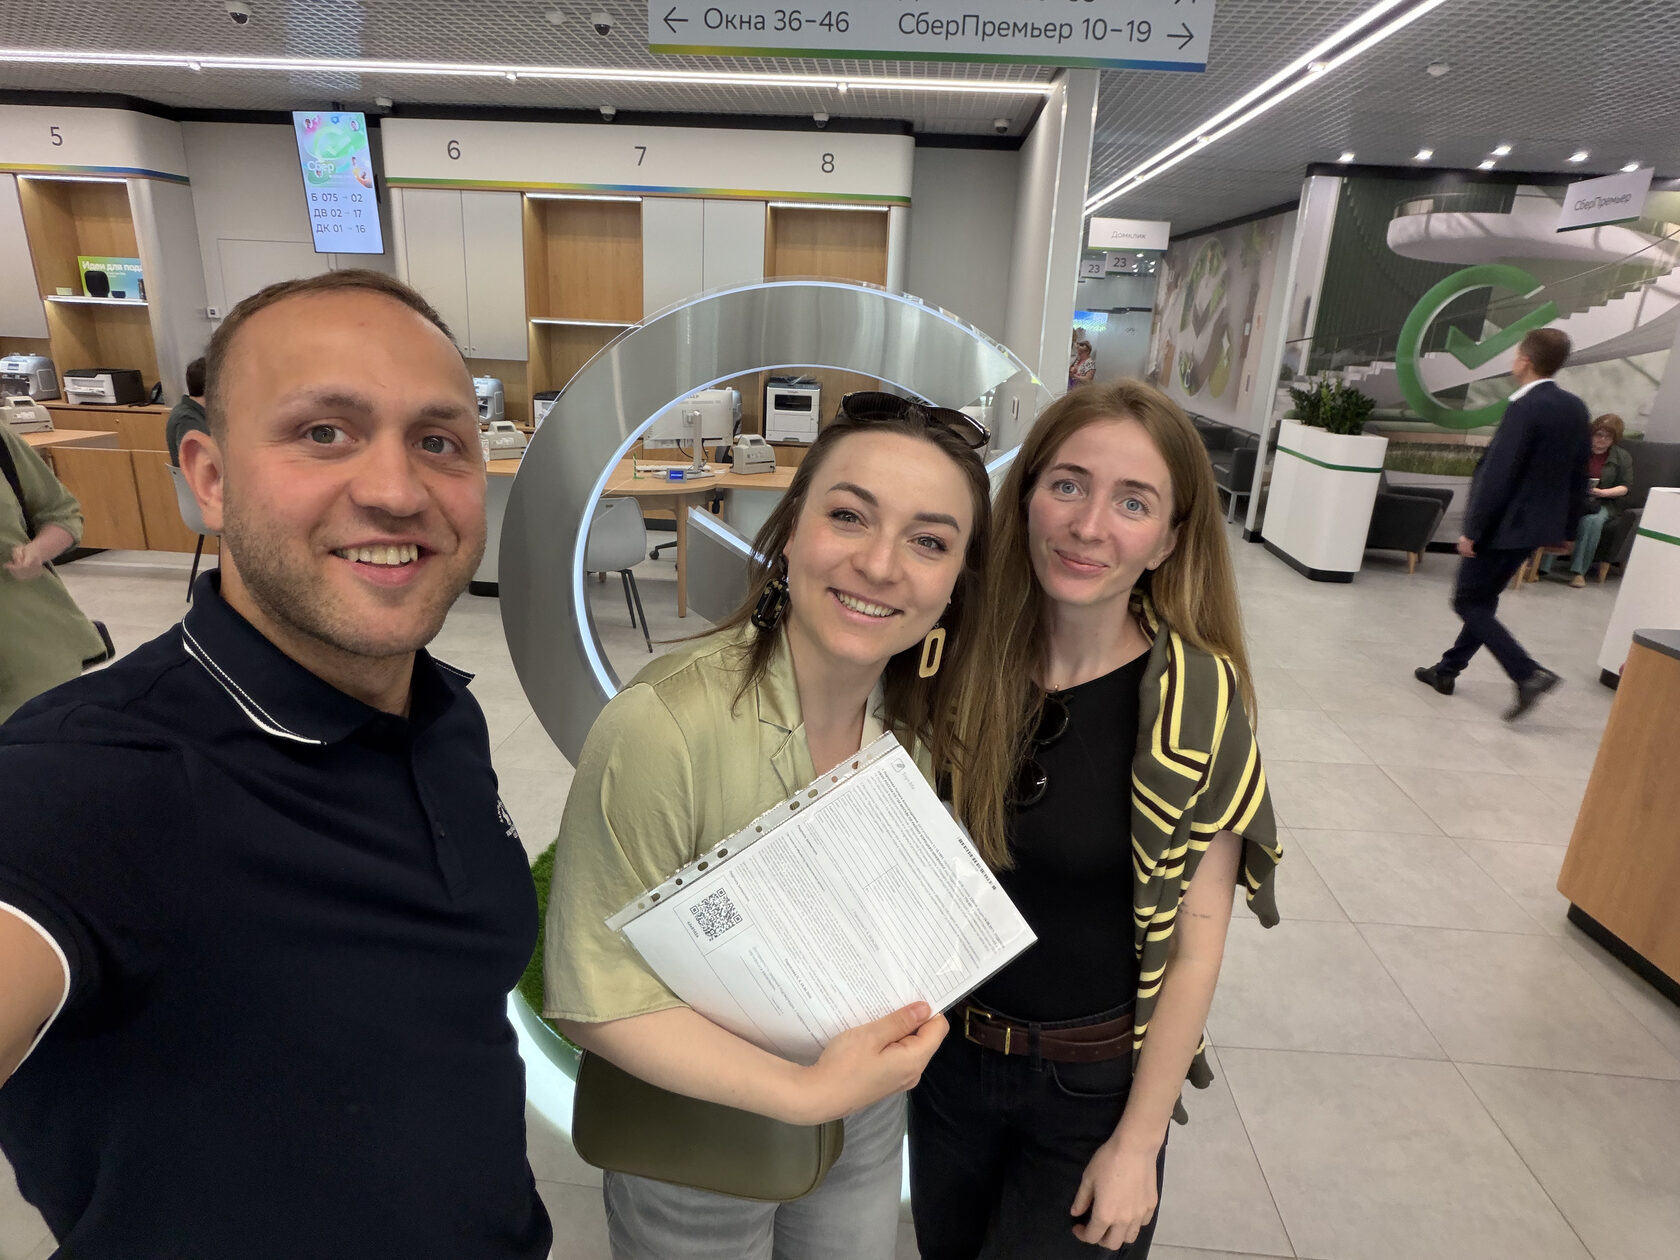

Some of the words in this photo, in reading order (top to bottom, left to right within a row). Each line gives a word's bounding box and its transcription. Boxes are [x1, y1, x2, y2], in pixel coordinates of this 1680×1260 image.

[703, 7, 766, 30] Окна
[774, 9, 850, 33] 36–46
[898, 12, 1073, 44] СберПремьер
[1081, 17, 1152, 42] 10–19
[49, 126, 63, 147] 5
[446, 139, 461, 161] 6
[634, 146, 647, 167] 7
[820, 153, 836, 174] 8
[311, 193, 318, 202] Б
[322, 193, 338, 202] 075
[351, 193, 363, 202] 02
[331, 209, 343, 217] 02
[353, 209, 362, 218] 17
[316, 223, 330, 233] ДК
[333, 224, 343, 233] 01
[355, 224, 366, 233] 16
[81, 261, 106, 271] Идеи
[106, 263, 123, 272] для
[123, 264, 143, 273] под
[1088, 264, 1100, 274] 23
[1113, 257, 1127, 268] 23
